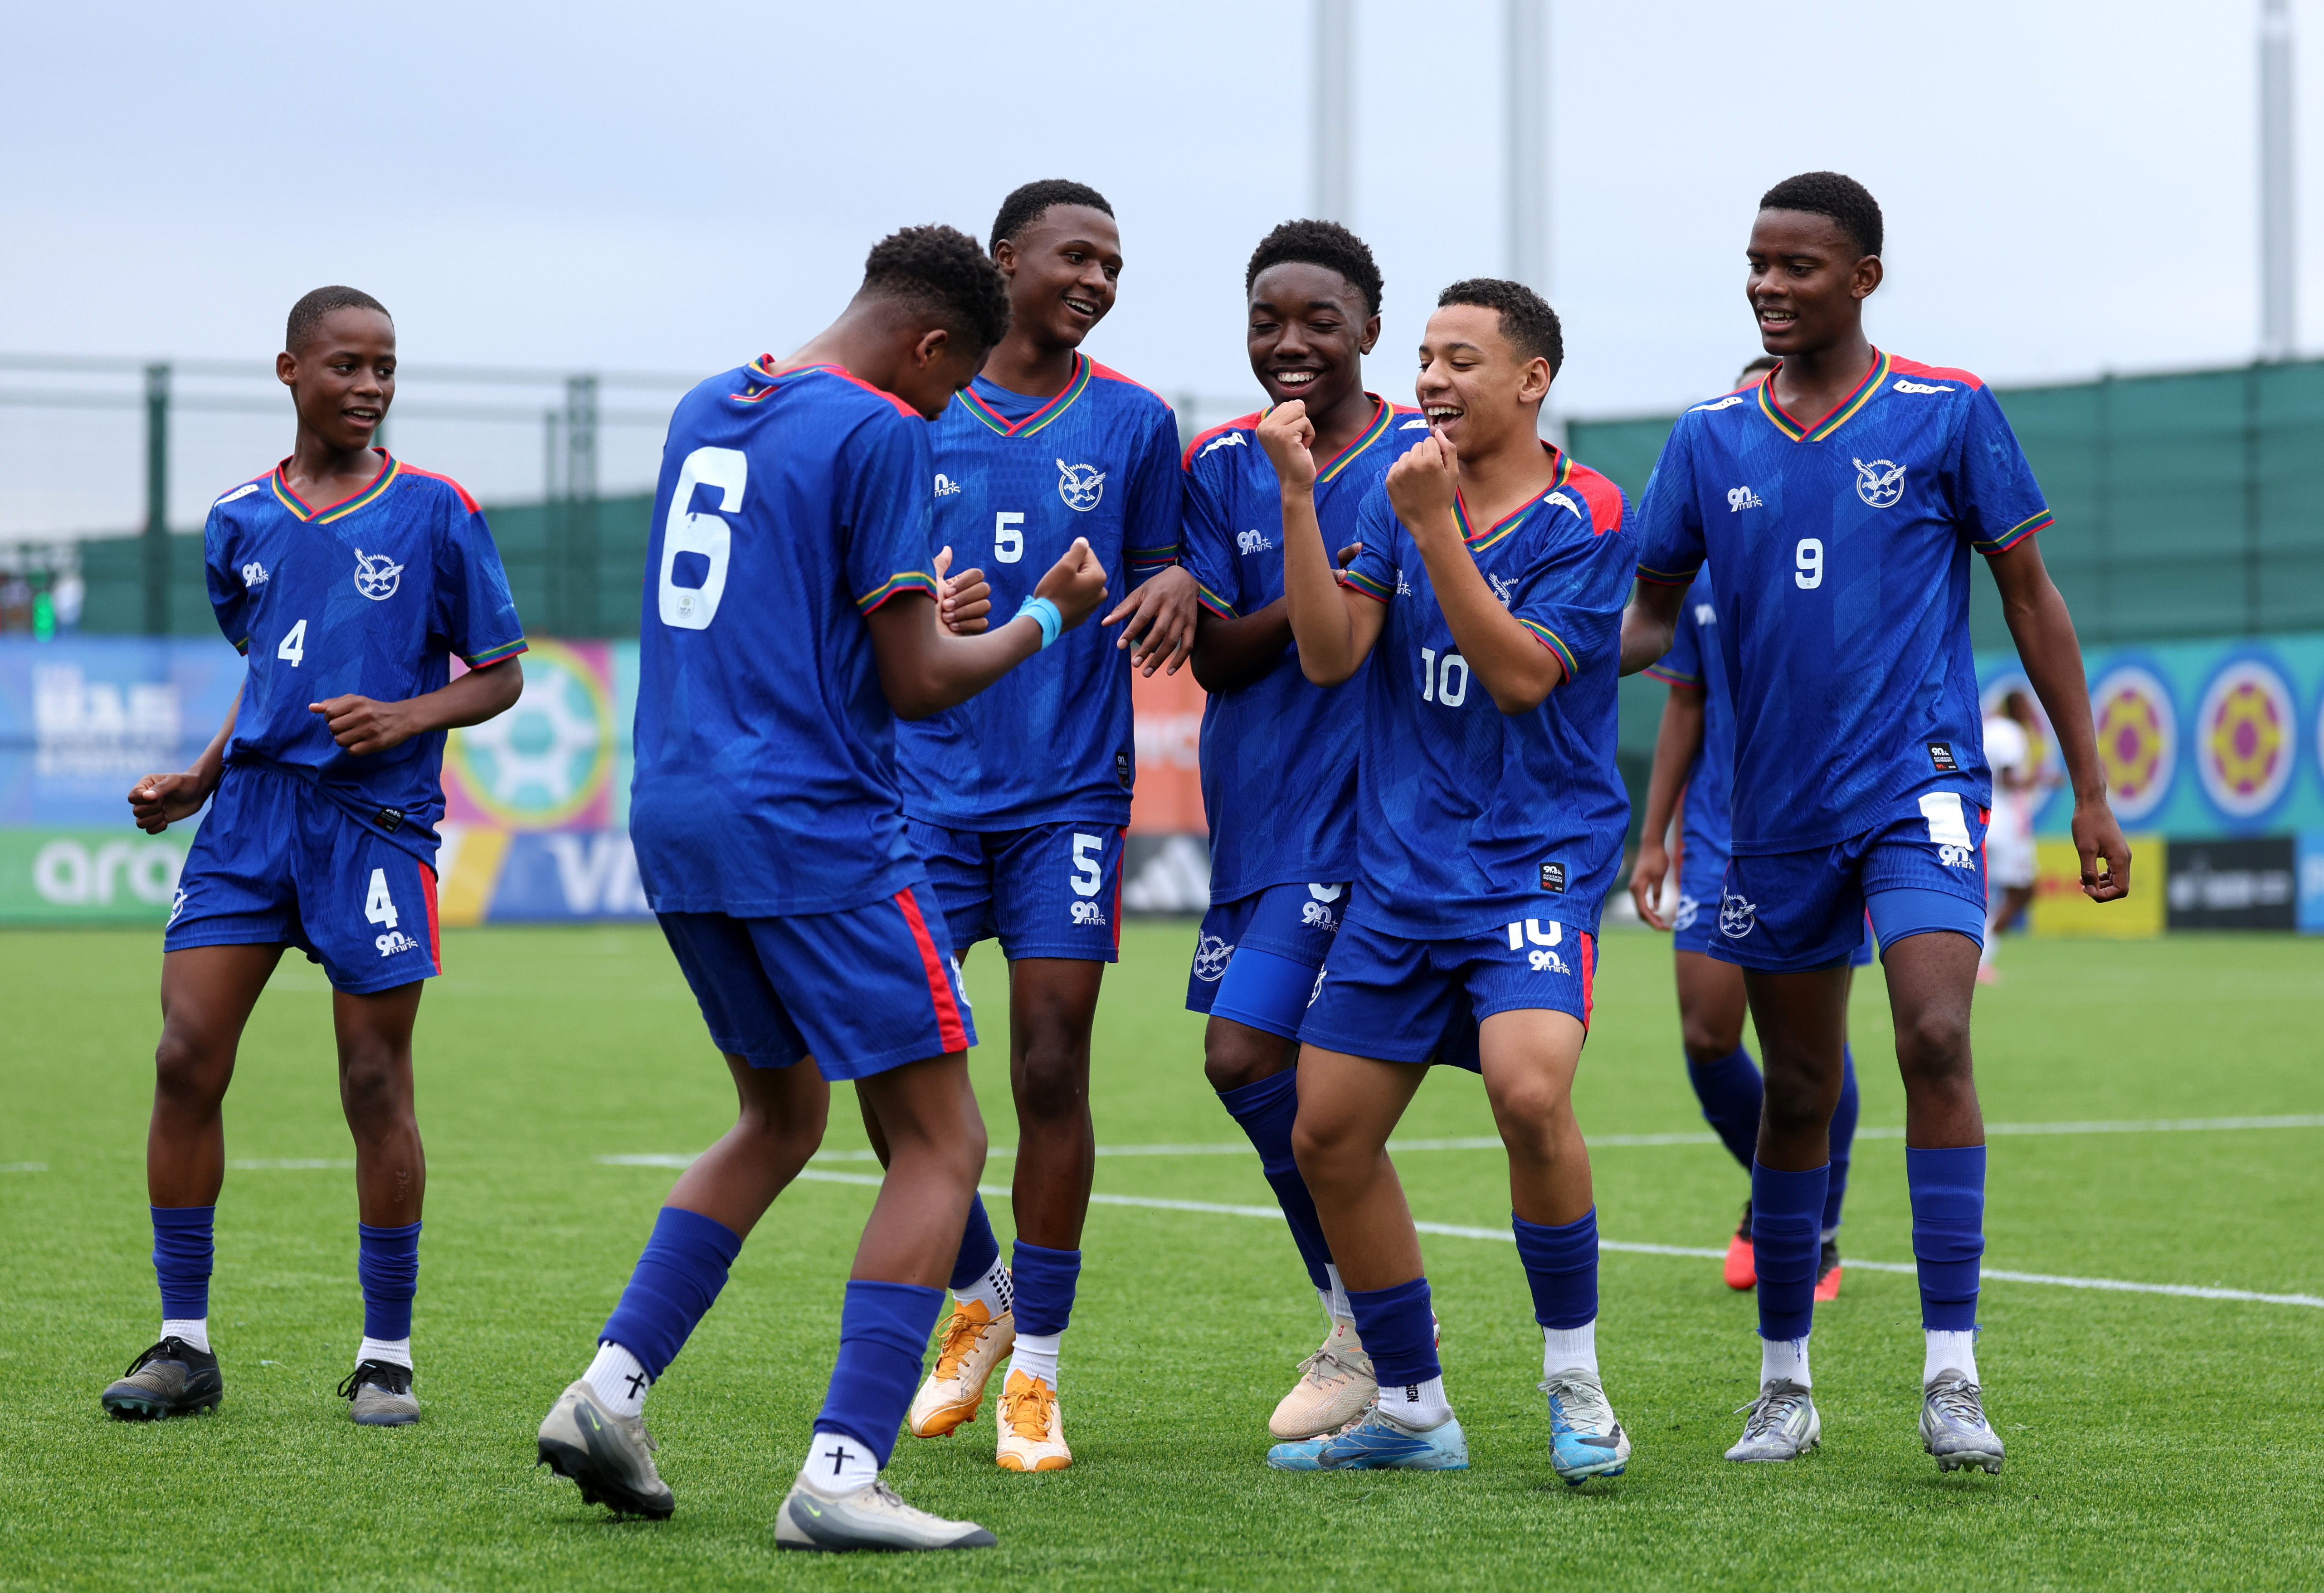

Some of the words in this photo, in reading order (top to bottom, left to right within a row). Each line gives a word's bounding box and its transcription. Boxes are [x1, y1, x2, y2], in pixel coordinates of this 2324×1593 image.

[1069, 463, 1098, 476] NAMIBIA
[1866, 459, 1896, 470] NAMIBIA
[367, 554, 395, 567] NAMIBIA
[659, 447, 748, 630] 6
[994, 512, 1024, 563] 5
[1795, 538, 1823, 589] 9
[278, 619, 307, 667] 4
[1422, 647, 1469, 707] 10
[1070, 833, 1102, 897] 5
[365, 868, 398, 929] 4
[1728, 894, 1748, 907] NAMIBIA
[1205, 935, 1225, 948] NAMIBIA
